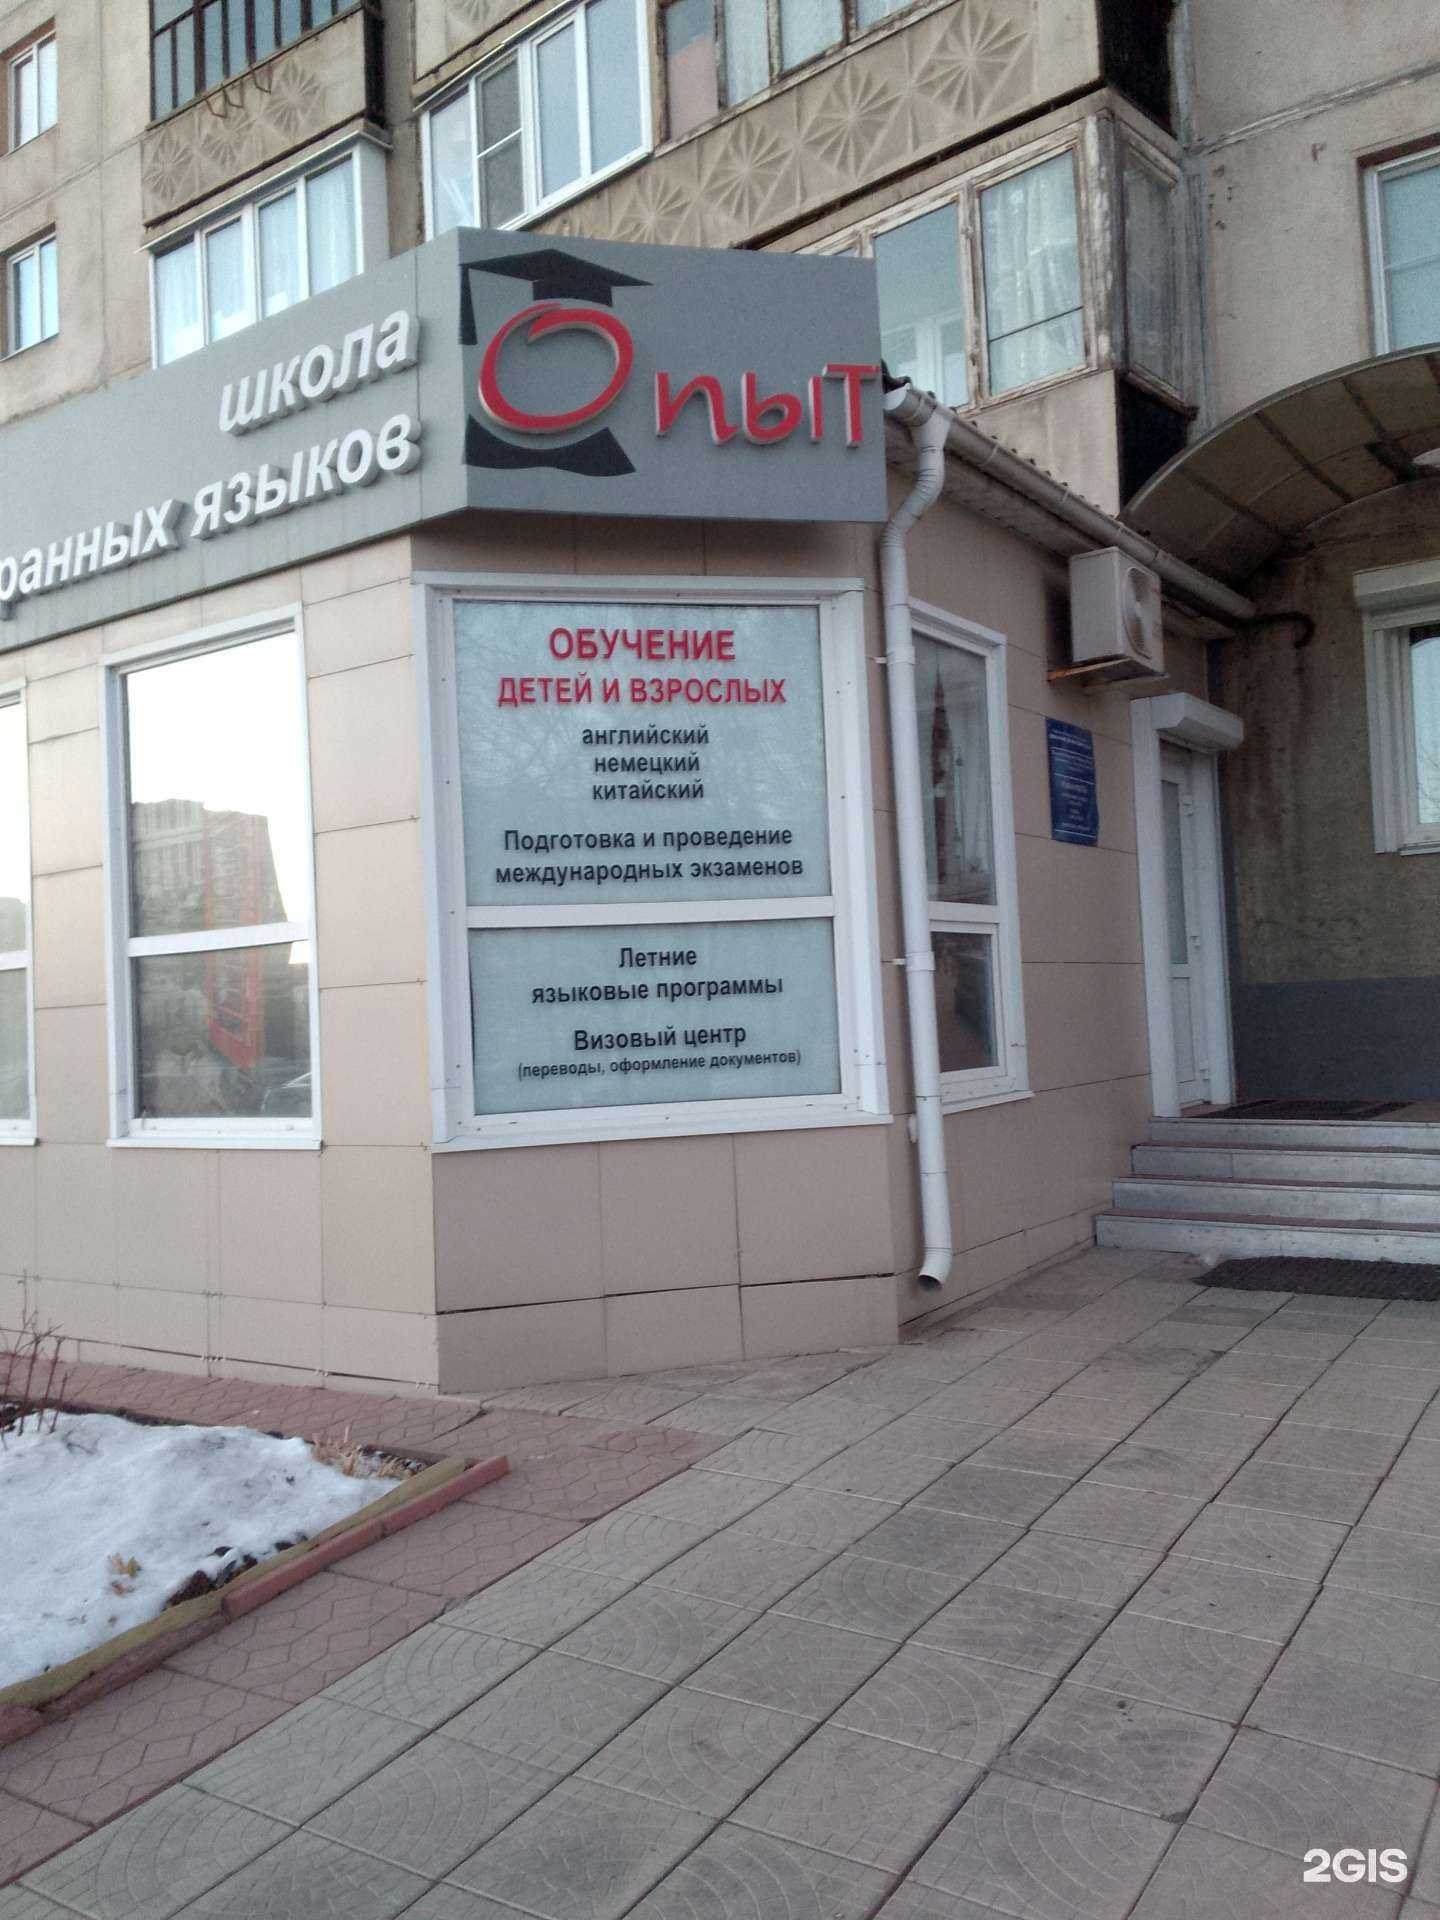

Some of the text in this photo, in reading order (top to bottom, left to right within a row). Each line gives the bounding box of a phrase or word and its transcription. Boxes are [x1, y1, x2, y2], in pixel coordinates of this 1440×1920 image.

[219, 310, 413, 433] школа
[477, 303, 881, 449] Опыт
[190, 413, 415, 538] языков
[550, 628, 736, 660] ОБУЧЕНИЕ
[498, 672, 787, 707] ДЕТЕЙ И ВЗРОСЛЫХ
[581, 724, 710, 746] английский
[593, 752, 701, 775] немецкий
[592, 778, 704, 801] китайский
[504, 827, 793, 854] Подготовка и проведение
[495, 856, 804, 886] международных экзаменов
[618, 947, 698, 969] Летние
[532, 975, 784, 1004] языковые программы
[573, 1025, 747, 1051] Визовый центр
[609, 1055, 706, 1075] оформление
[710, 1048, 802, 1070] документов)
